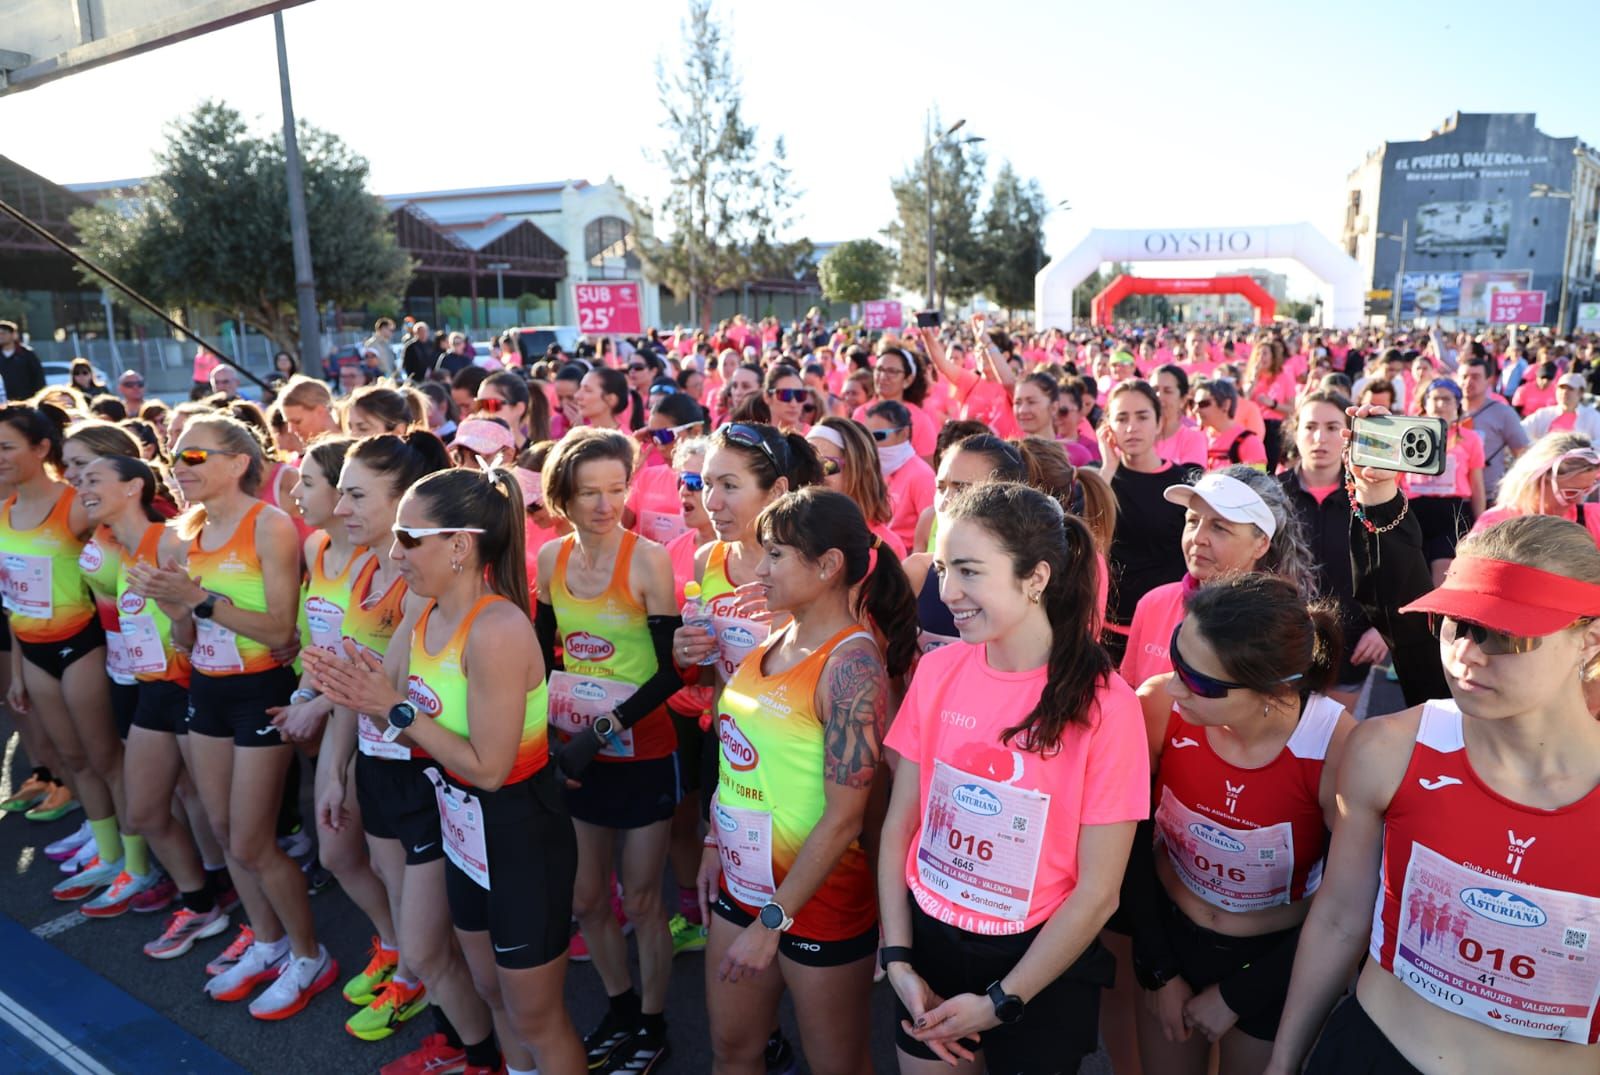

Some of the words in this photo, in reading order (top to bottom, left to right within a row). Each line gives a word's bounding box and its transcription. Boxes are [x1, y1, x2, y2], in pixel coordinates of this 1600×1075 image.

[1411, 153, 1459, 170] PUERTO
[1145, 231, 1251, 254] OYSHO
[578, 286, 611, 303] SUB
[1496, 295, 1522, 306] SUB
[580, 306, 615, 330] 25'
[568, 638, 610, 654] Serrano
[408, 686, 436, 711] errano
[720, 721, 753, 762] errano
[736, 783, 765, 802] CORRE
[954, 788, 998, 813] ASTURIANA
[1196, 802, 1211, 813] Club
[948, 829, 994, 861] 016
[1193, 824, 1242, 850] ASTURIANA
[1507, 844, 1526, 856] CAX
[952, 856, 974, 872] 4645
[1193, 855, 1246, 882] 016
[1462, 860, 1482, 873] Club
[922, 867, 949, 890] OYSHO
[943, 864, 950, 874] DE
[950, 868, 957, 878] LA
[957, 870, 978, 885] MUJER
[982, 878, 1013, 896] VALENCIA
[1210, 877, 1223, 886] 42
[1420, 875, 1452, 898] SUMA
[970, 893, 1013, 912] Santander
[1231, 899, 1275, 908] Santander
[1465, 892, 1539, 924] ASTURIANA
[940, 909, 955, 925] DE
[958, 915, 975, 932] LA
[977, 921, 1025, 936] MUJER
[1458, 937, 1537, 980] 016
[1409, 970, 1464, 1006] OYSHO
[1414, 957, 1450, 983] CARRERA
[1452, 977, 1464, 989] DE
[1466, 982, 1479, 993] LA
[1480, 986, 1513, 1006] MUJER
[1521, 1000, 1566, 1015] VALENCIA
[1477, 973, 1496, 986] 41
[1503, 1013, 1567, 1032] Santander
